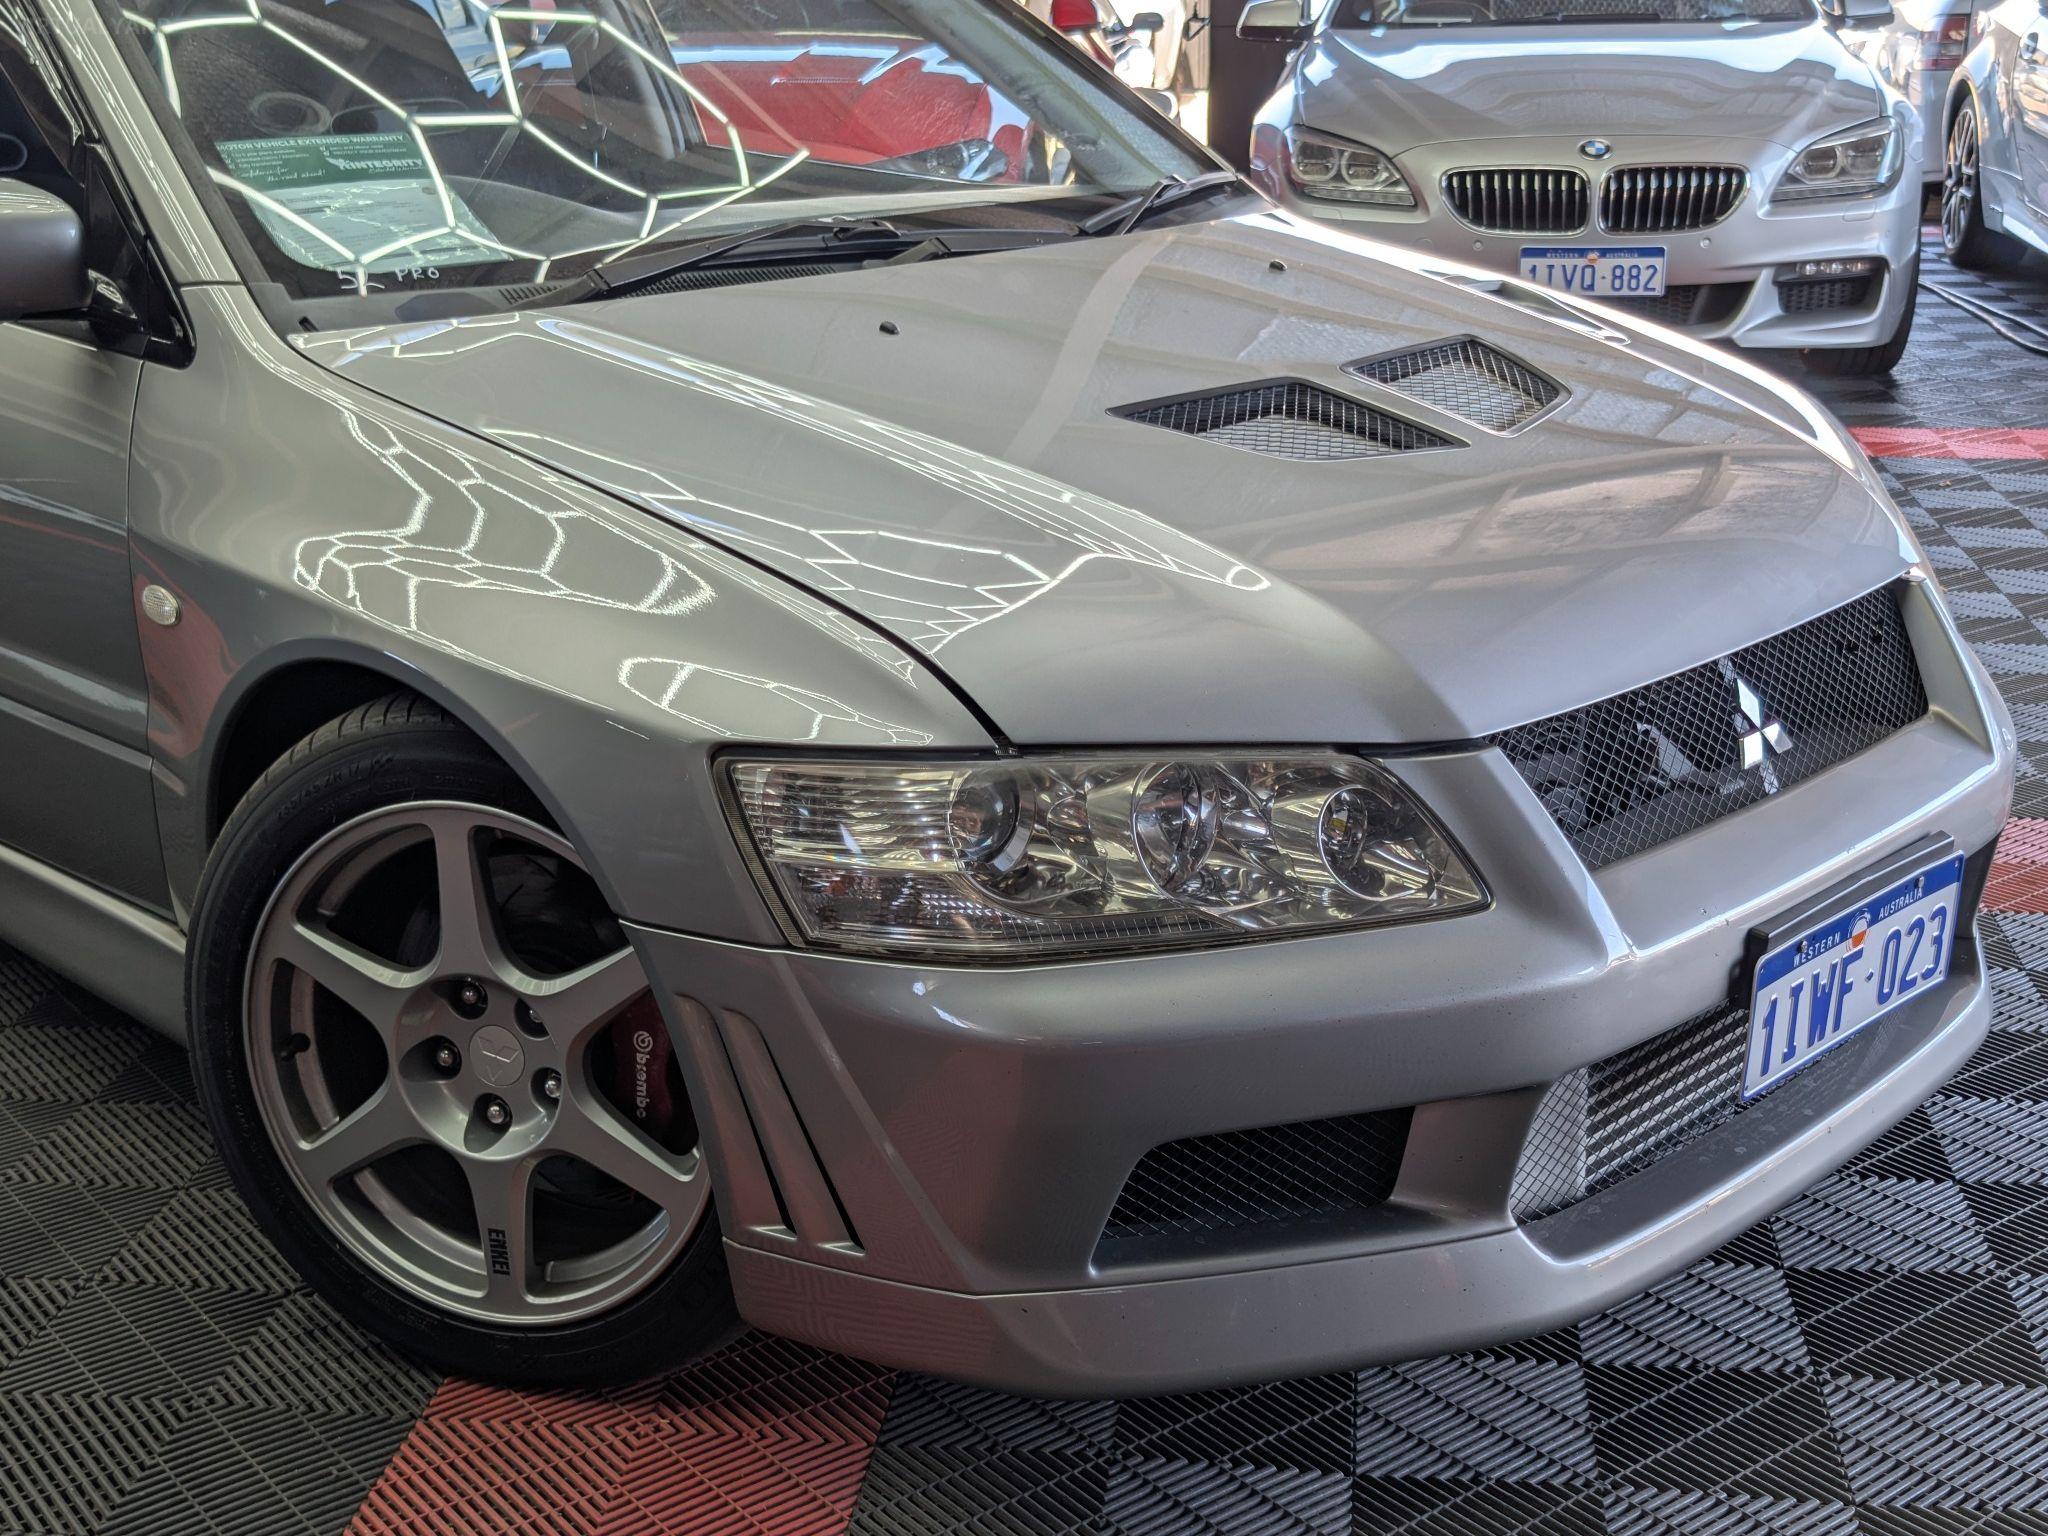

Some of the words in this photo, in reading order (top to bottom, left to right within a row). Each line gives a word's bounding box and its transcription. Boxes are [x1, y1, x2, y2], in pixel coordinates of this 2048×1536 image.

[217, 141, 254, 152] MOTOR
[253, 138, 296, 149] VEHICLE
[297, 136, 350, 147] EXTENDED
[350, 134, 404, 145] WARRANTY
[347, 158, 425, 170] INTEGRITY
[395, 265, 440, 282] PRO
[1792, 931, 1841, 968] WESTERN
[1878, 887, 1924, 920] AUSTRALIA
[635, 1052, 651, 1119] brembo
[487, 1228, 511, 1276] ENKEI
